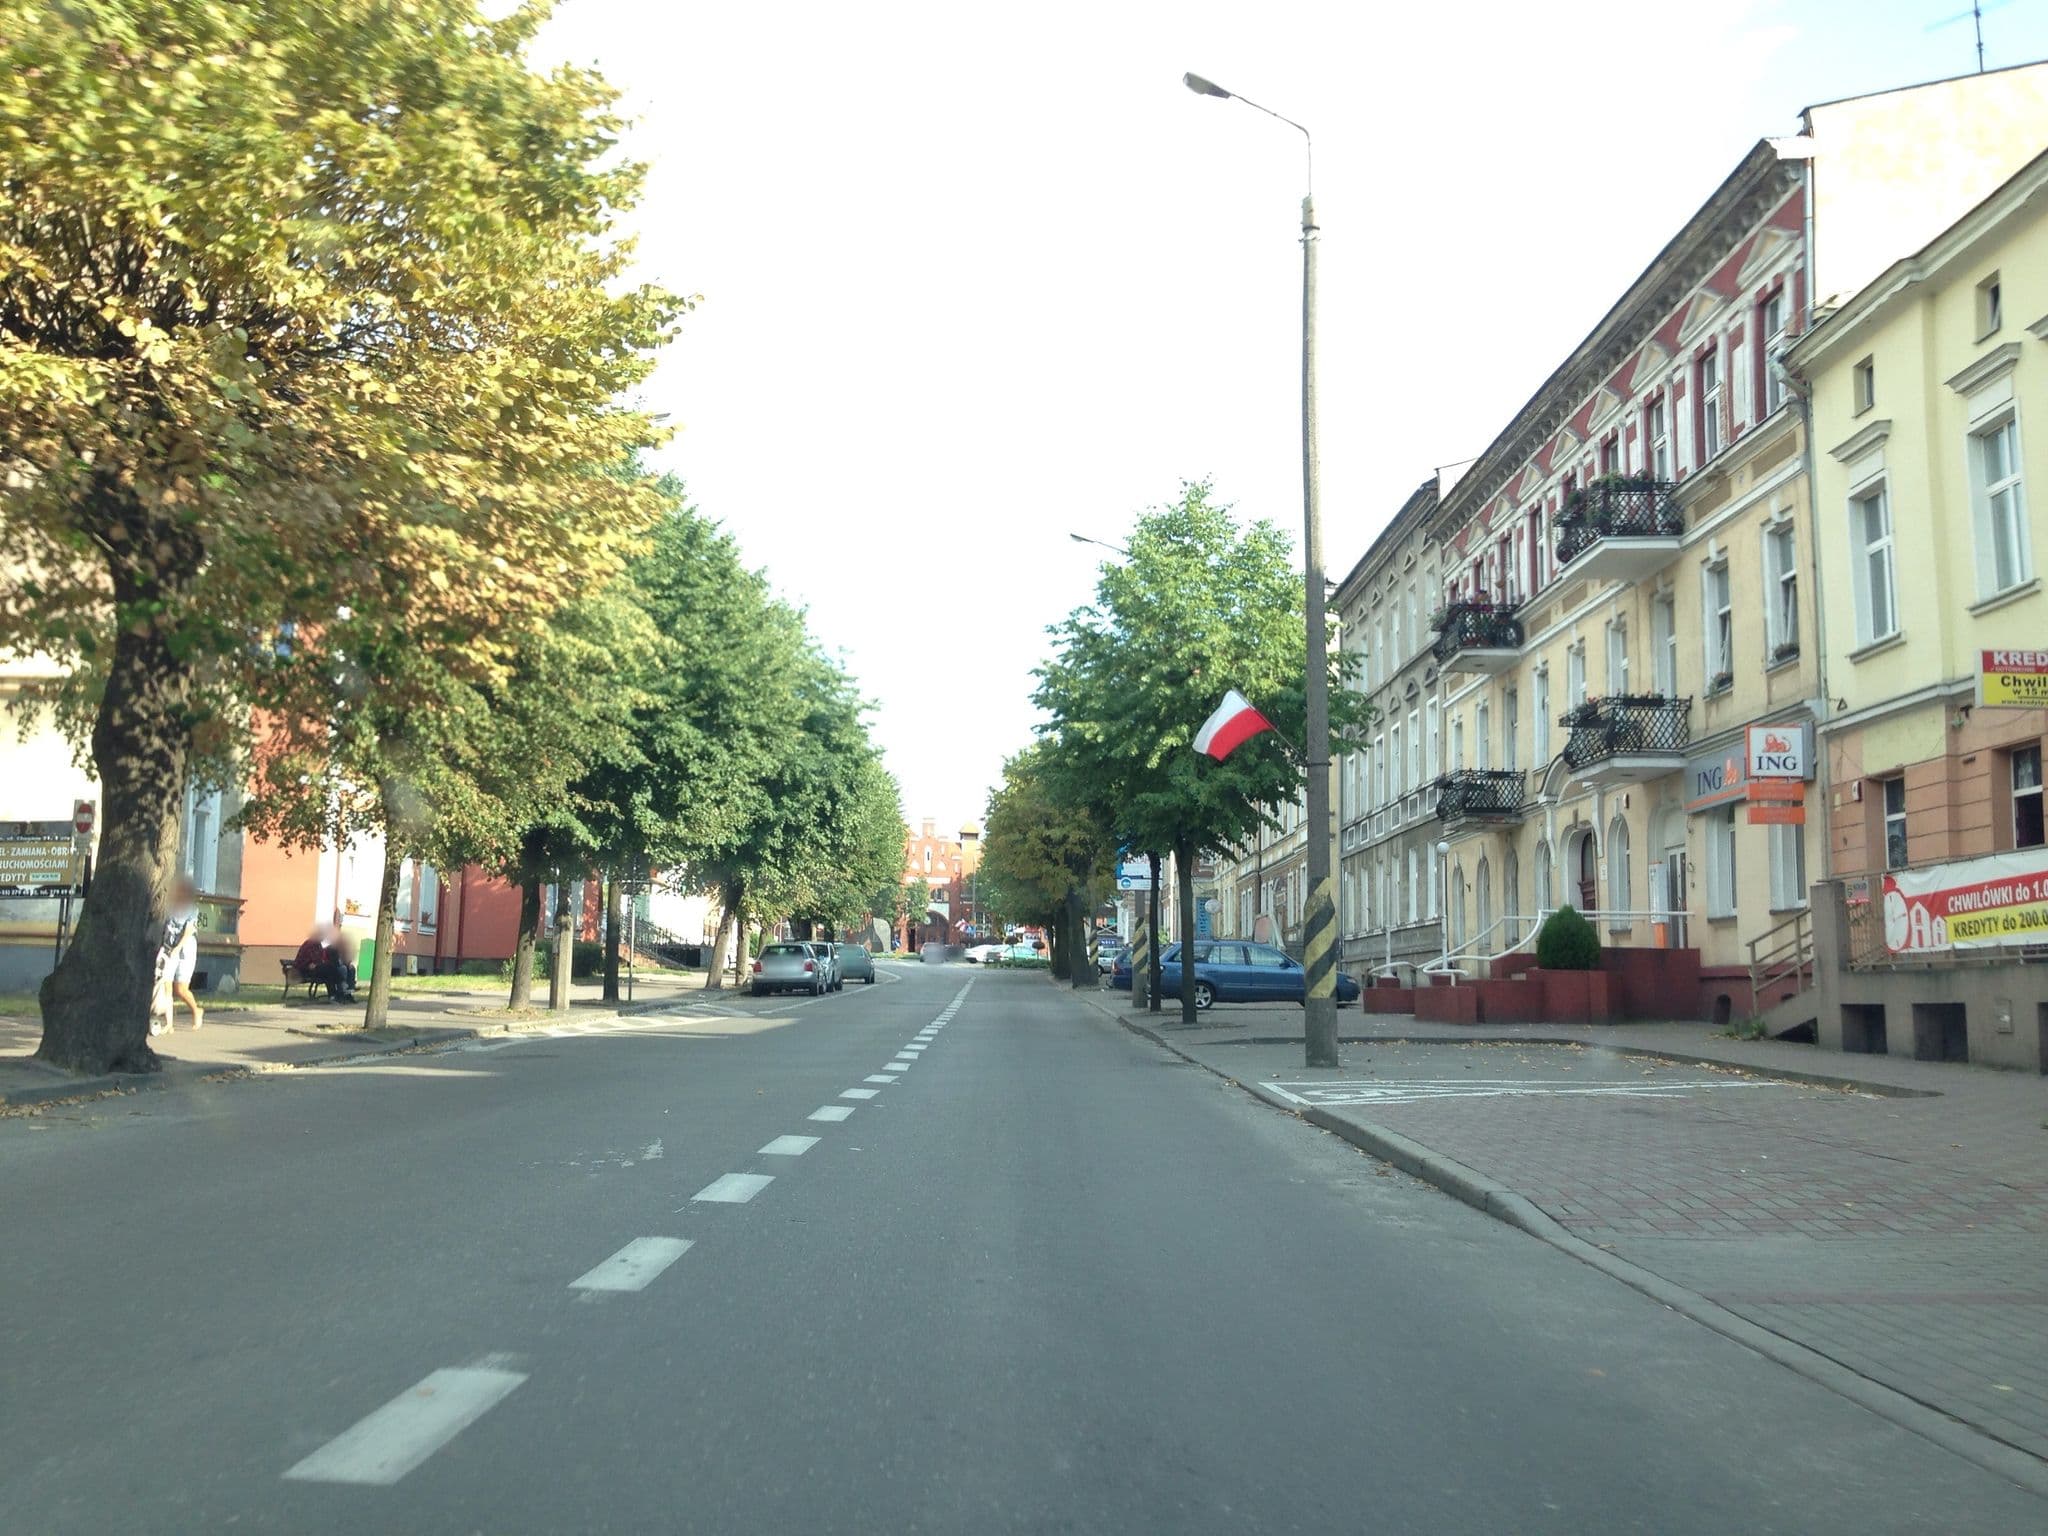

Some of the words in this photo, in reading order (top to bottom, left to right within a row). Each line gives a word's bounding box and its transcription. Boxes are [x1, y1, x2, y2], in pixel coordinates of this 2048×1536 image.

[1993, 651, 2048, 666] KRED
[2000, 675, 2047, 688] Chwil
[1757, 756, 1797, 771] ING
[1697, 766, 1722, 796] ING
[11, 847, 47, 856] ZAMIANA
[1948, 885, 2012, 912] CHWILÓWKI
[2016, 883, 2030, 902] do
[1954, 916, 1999, 938] KREDYTY
[2002, 914, 2017, 931] do
